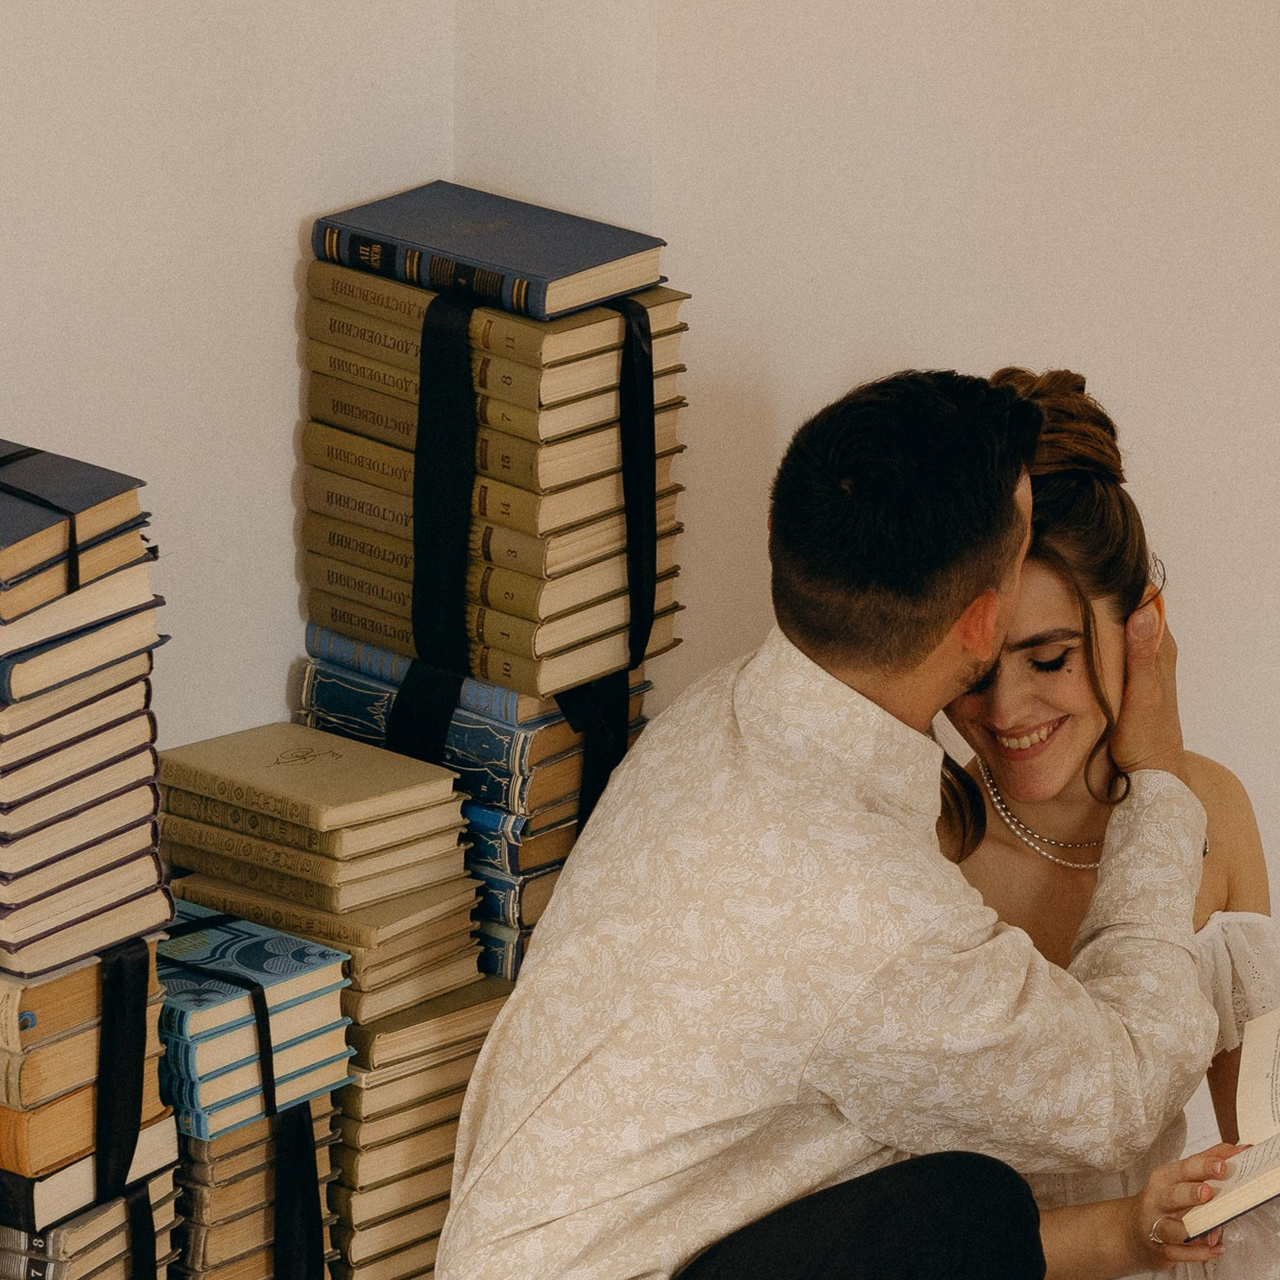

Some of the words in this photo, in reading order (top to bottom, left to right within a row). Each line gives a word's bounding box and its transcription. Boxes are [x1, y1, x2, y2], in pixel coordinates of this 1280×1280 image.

[505, 335, 516, 351] 11
[501, 375, 513, 386] 8
[331, 399, 416, 436] ДОСТОЕВСКИЙ
[501, 412, 512, 423] 7
[326, 445, 413, 482] ДОСТОЕВСКИЙ
[501, 454, 511, 471] 15
[326, 490, 414, 528] ДОСТОЕВСКИЙ
[500, 502, 511, 518] 14
[328, 531, 414, 569] ДОСТОЕВСКИЙ
[507, 548, 518, 559] 3
[327, 569, 412, 607] ДОСТОЕВСКИЙ
[504, 591, 516, 601] 2
[330, 607, 413, 644] ДОСТОЕВСКИЙ
[500, 631, 511, 639] 1
[502, 662, 512, 679] 10
[32, 1238, 45, 1248] 8
[30, 1268, 43, 1278] 7
